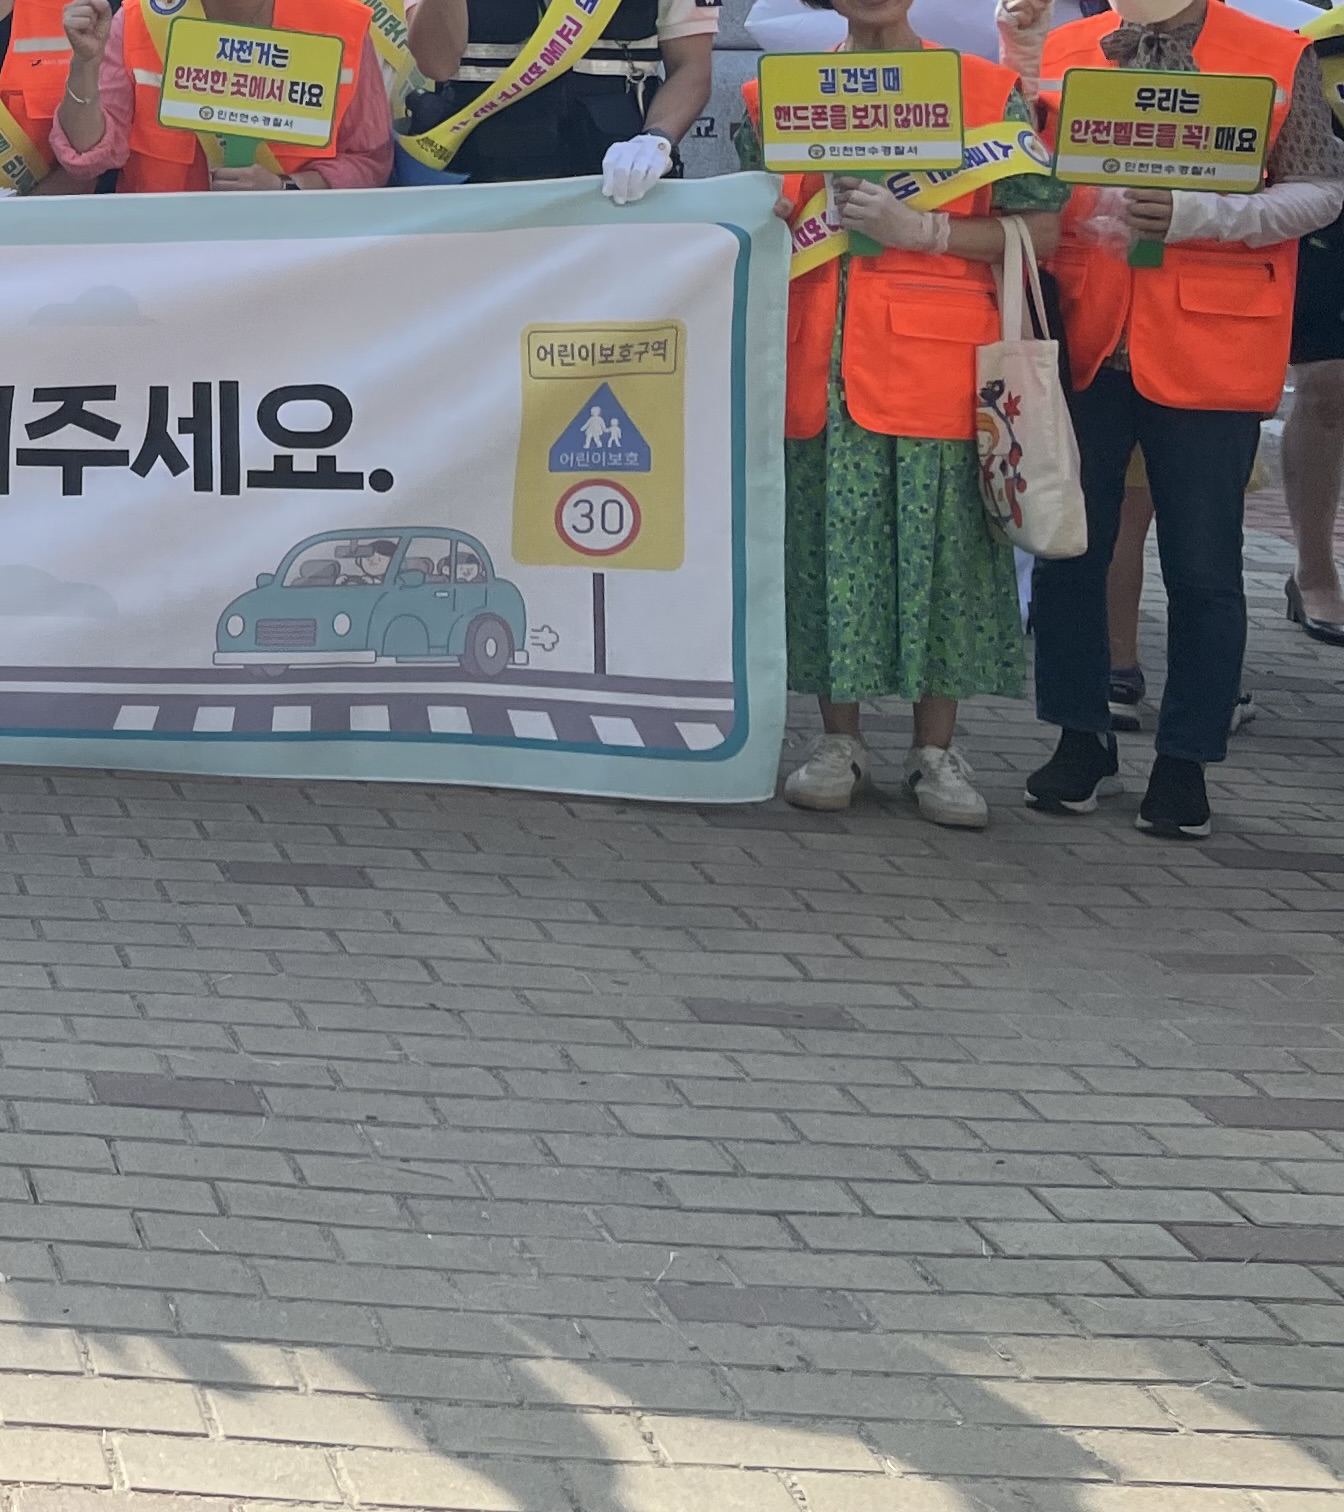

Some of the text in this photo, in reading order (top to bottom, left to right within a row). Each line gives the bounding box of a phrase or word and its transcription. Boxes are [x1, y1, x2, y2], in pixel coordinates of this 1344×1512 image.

[216, 37, 290, 68] 자전거는
[174, 65, 324, 108] 안전한 곳에서 타요
[818, 67, 901, 94] 길 건널 때
[1134, 87, 1200, 115] 우리는
[217, 109, 294, 129] 인천연수경찰서
[773, 103, 950, 131] 핸드폰을 보지 않아요
[1070, 119, 1257, 153] 안전벨트를 꼭! 매요
[829, 145, 918, 157] 인천연수경찰서
[1124, 161, 1216, 177] 인천연수경찰서
[535, 338, 669, 367] 어린이보호구역
[558, 450, 641, 468] 어린이보호
[570, 497, 625, 536] 30
